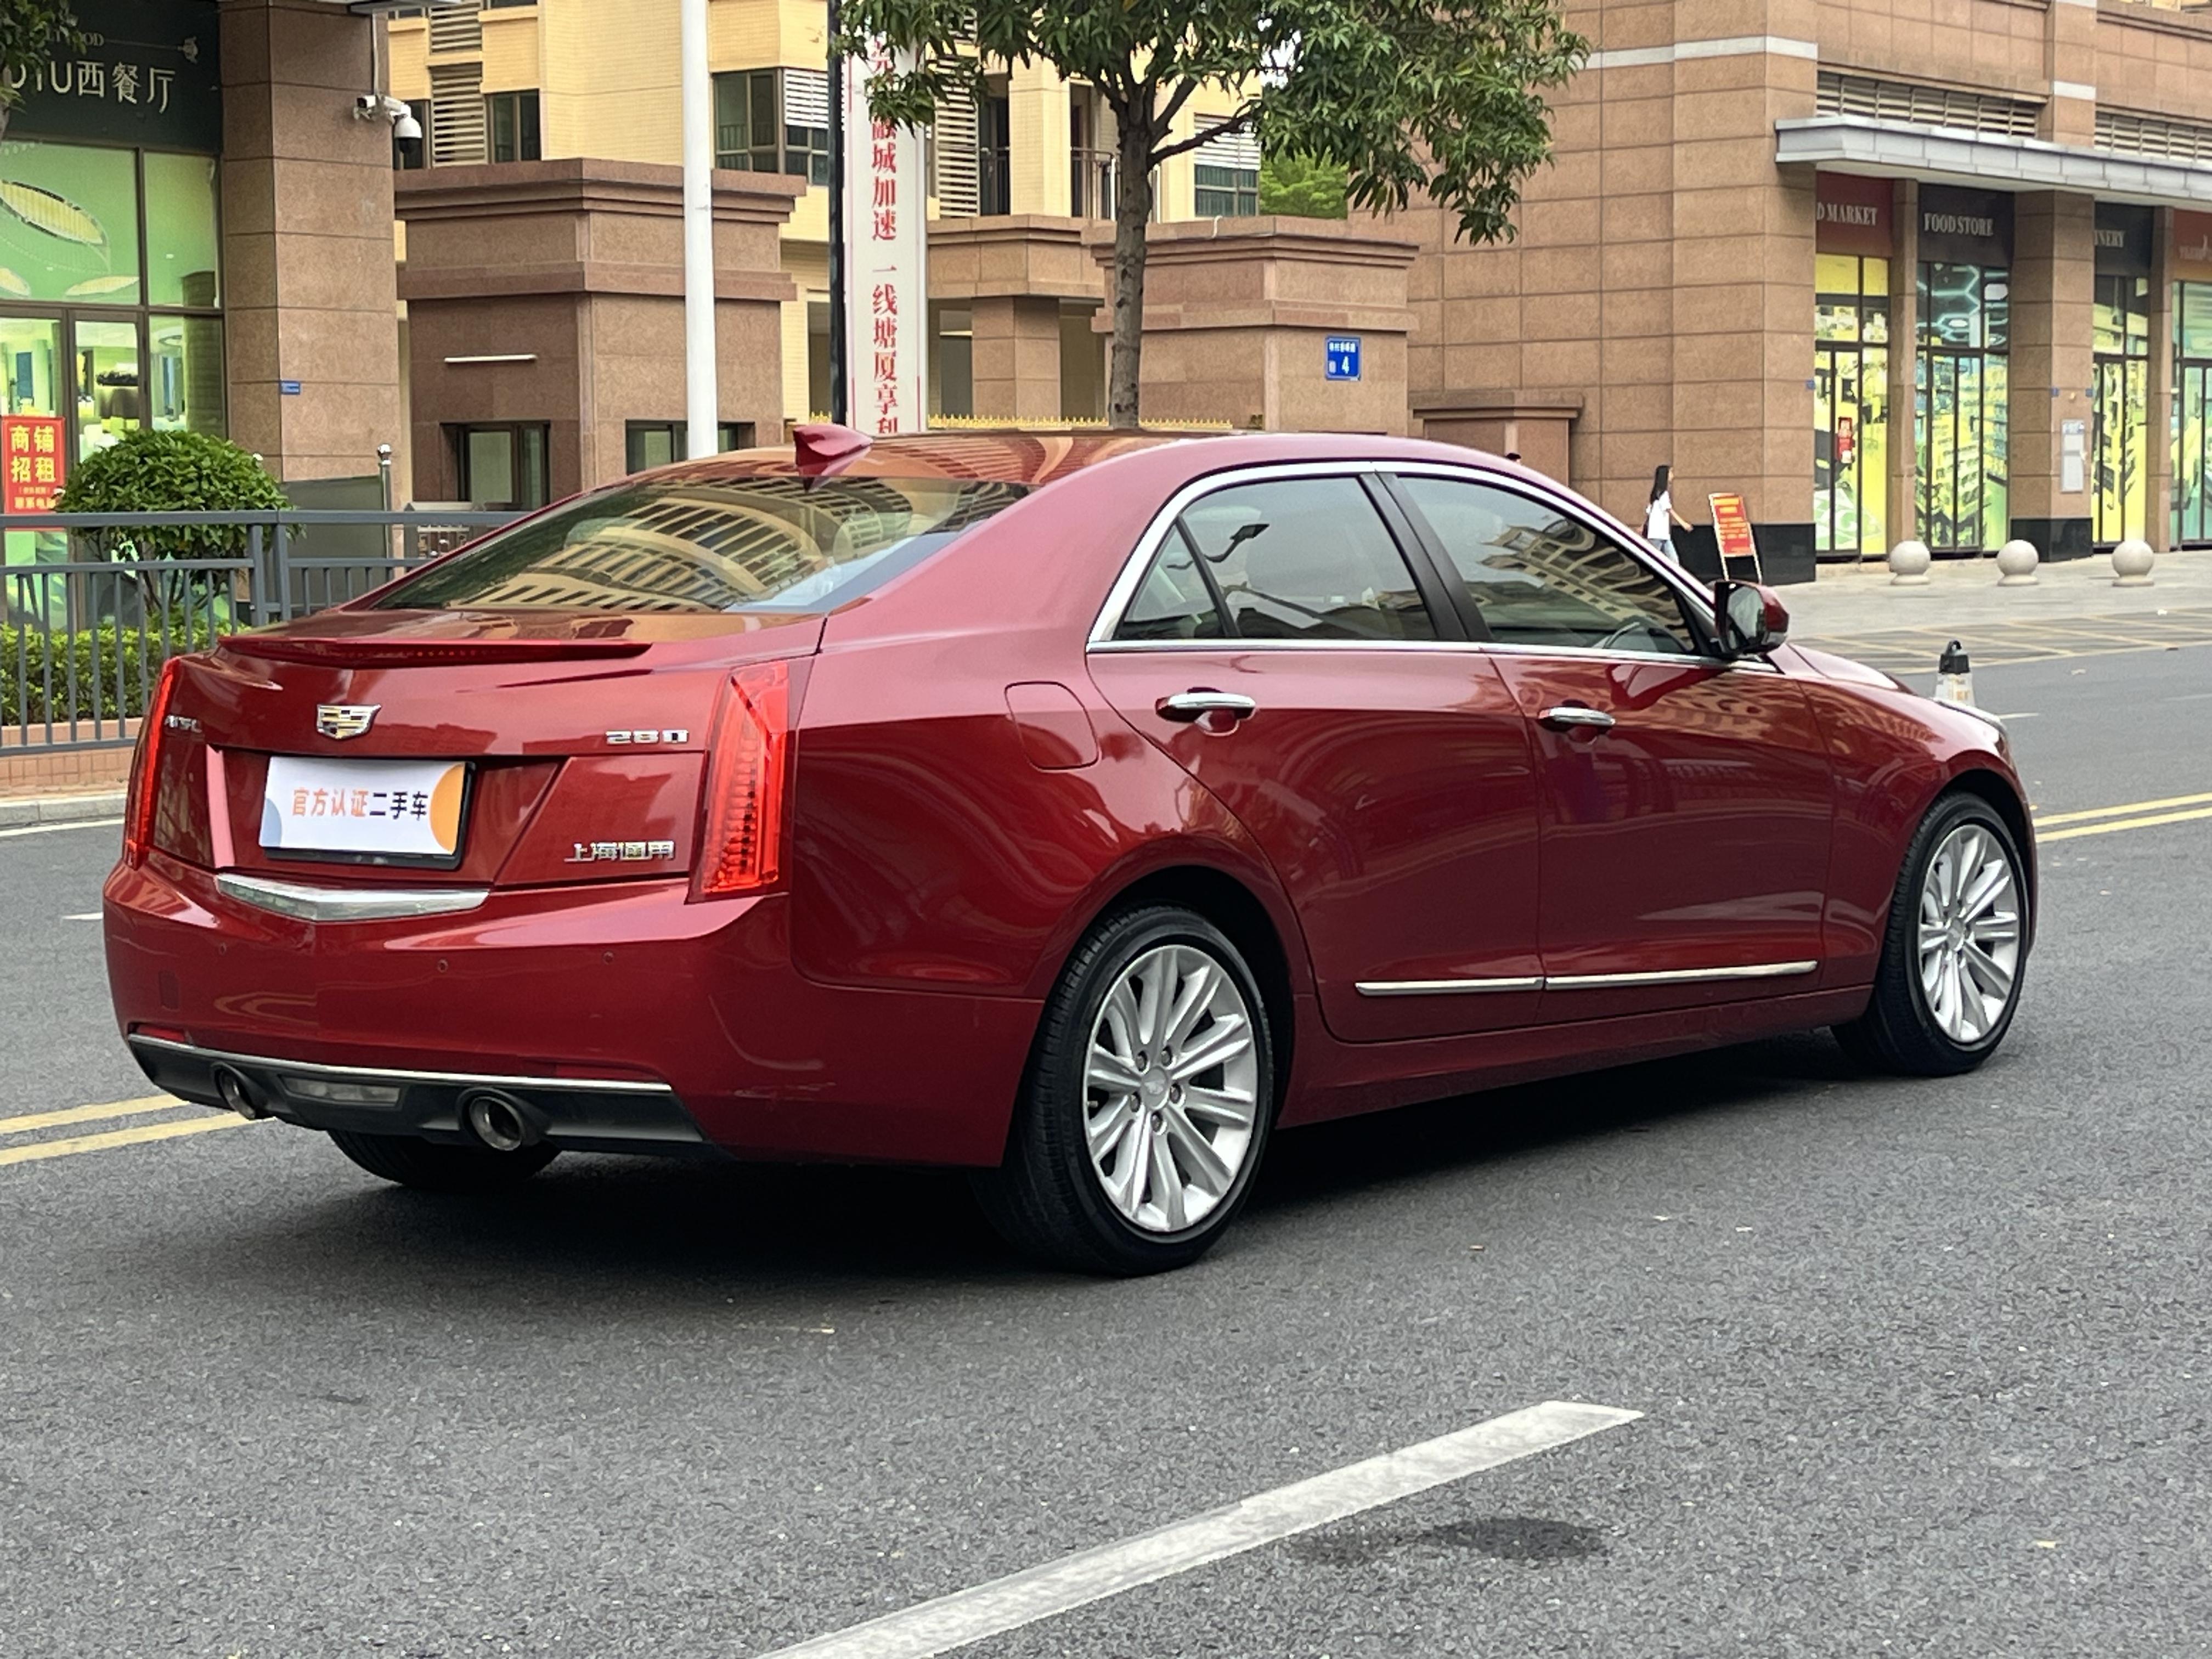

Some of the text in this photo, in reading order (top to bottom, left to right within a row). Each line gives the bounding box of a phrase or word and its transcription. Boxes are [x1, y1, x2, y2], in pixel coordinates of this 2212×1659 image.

[1827, 202, 1878, 225] MARKET
[10, 455, 56, 483] 招租
[292, 787, 428, 821] 官方认证二手车
[563, 840, 675, 862] 上海通用
